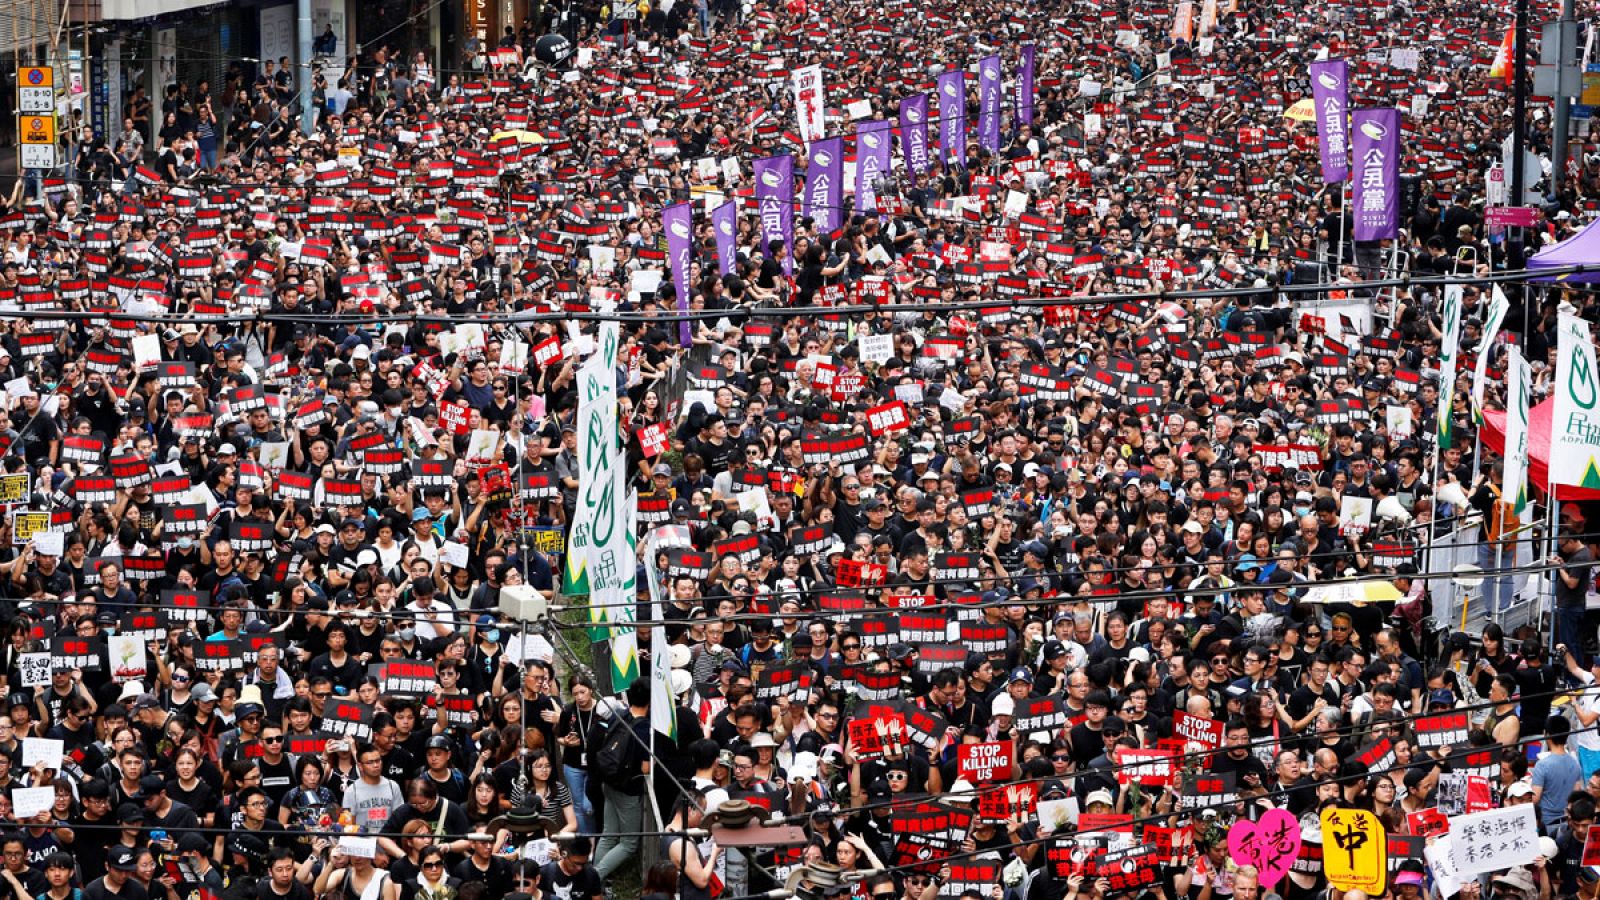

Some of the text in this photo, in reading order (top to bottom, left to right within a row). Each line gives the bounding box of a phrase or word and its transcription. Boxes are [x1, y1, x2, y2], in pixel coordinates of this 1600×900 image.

[840, 377, 861, 385] STOP
[897, 597, 926, 608] STOP
[321, 718, 368, 737] 沒有暴動
[1017, 713, 1066, 730] 沒有暴動
[1183, 715, 1212, 730] STOP
[852, 724, 874, 737] 孩子
[1175, 723, 1217, 743] KILLING
[970, 745, 1001, 757] STOP
[963, 755, 1008, 770] KILLING
[977, 768, 993, 780] US
[1238, 818, 1294, 860] 香港
[1332, 823, 1369, 871] 中
